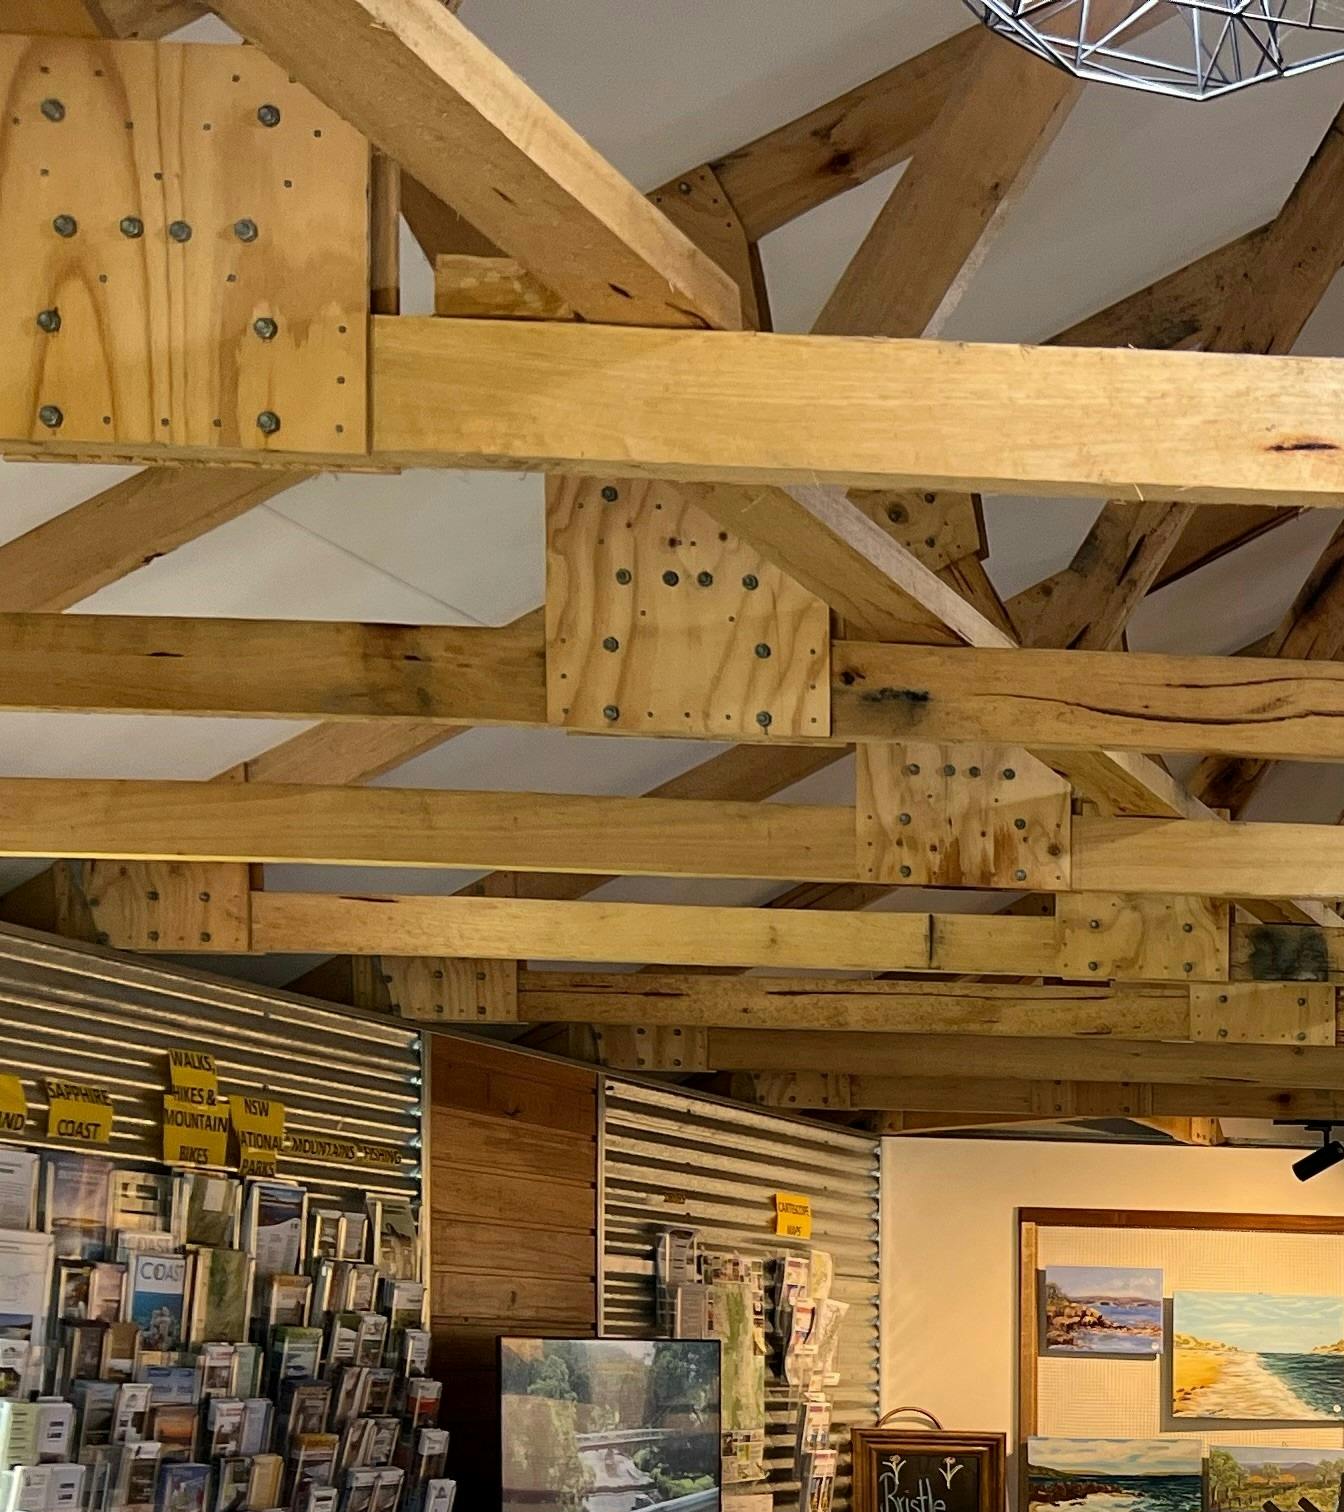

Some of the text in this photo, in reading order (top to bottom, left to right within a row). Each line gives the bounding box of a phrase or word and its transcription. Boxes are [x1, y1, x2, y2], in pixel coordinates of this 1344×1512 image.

[170, 1050, 216, 1075] WALKS,
[47, 1082, 112, 1106] SAPPHIRE
[172, 1087, 217, 1106] HIKES &
[244, 1099, 270, 1117] NSW
[57, 1119, 101, 1139] COAST
[164, 1109, 229, 1133] MOUNTAIN
[179, 1145, 209, 1164] BIKES
[290, 1134, 356, 1160] MOUNTAINS
[241, 1158, 275, 1178] PARKS
[139, 1261, 185, 1281] COAST
